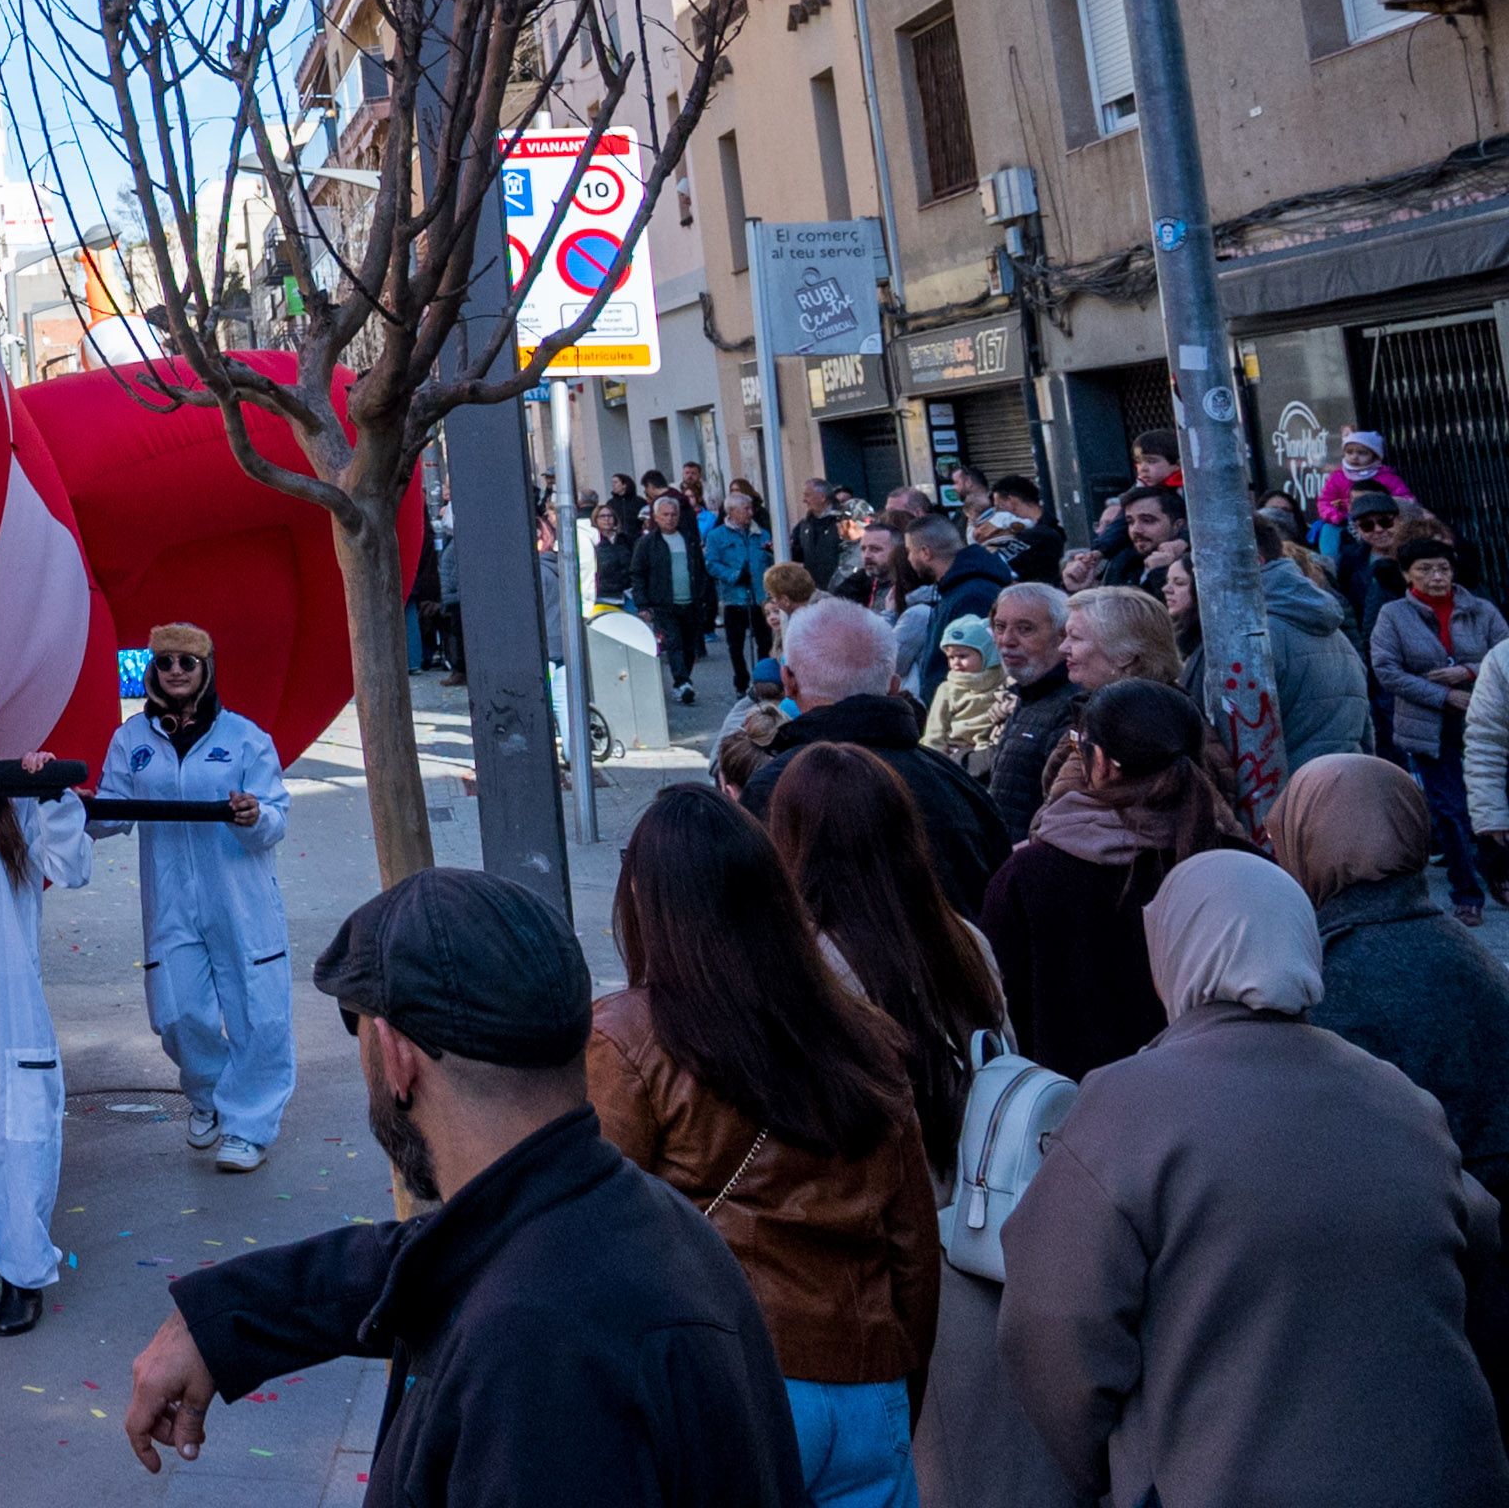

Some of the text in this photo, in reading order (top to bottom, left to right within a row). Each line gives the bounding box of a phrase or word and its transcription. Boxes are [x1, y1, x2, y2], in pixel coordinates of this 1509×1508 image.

[583, 182, 610, 199] 10
[775, 228, 859, 243] El comerç
[771, 244, 866, 259] al teu servei
